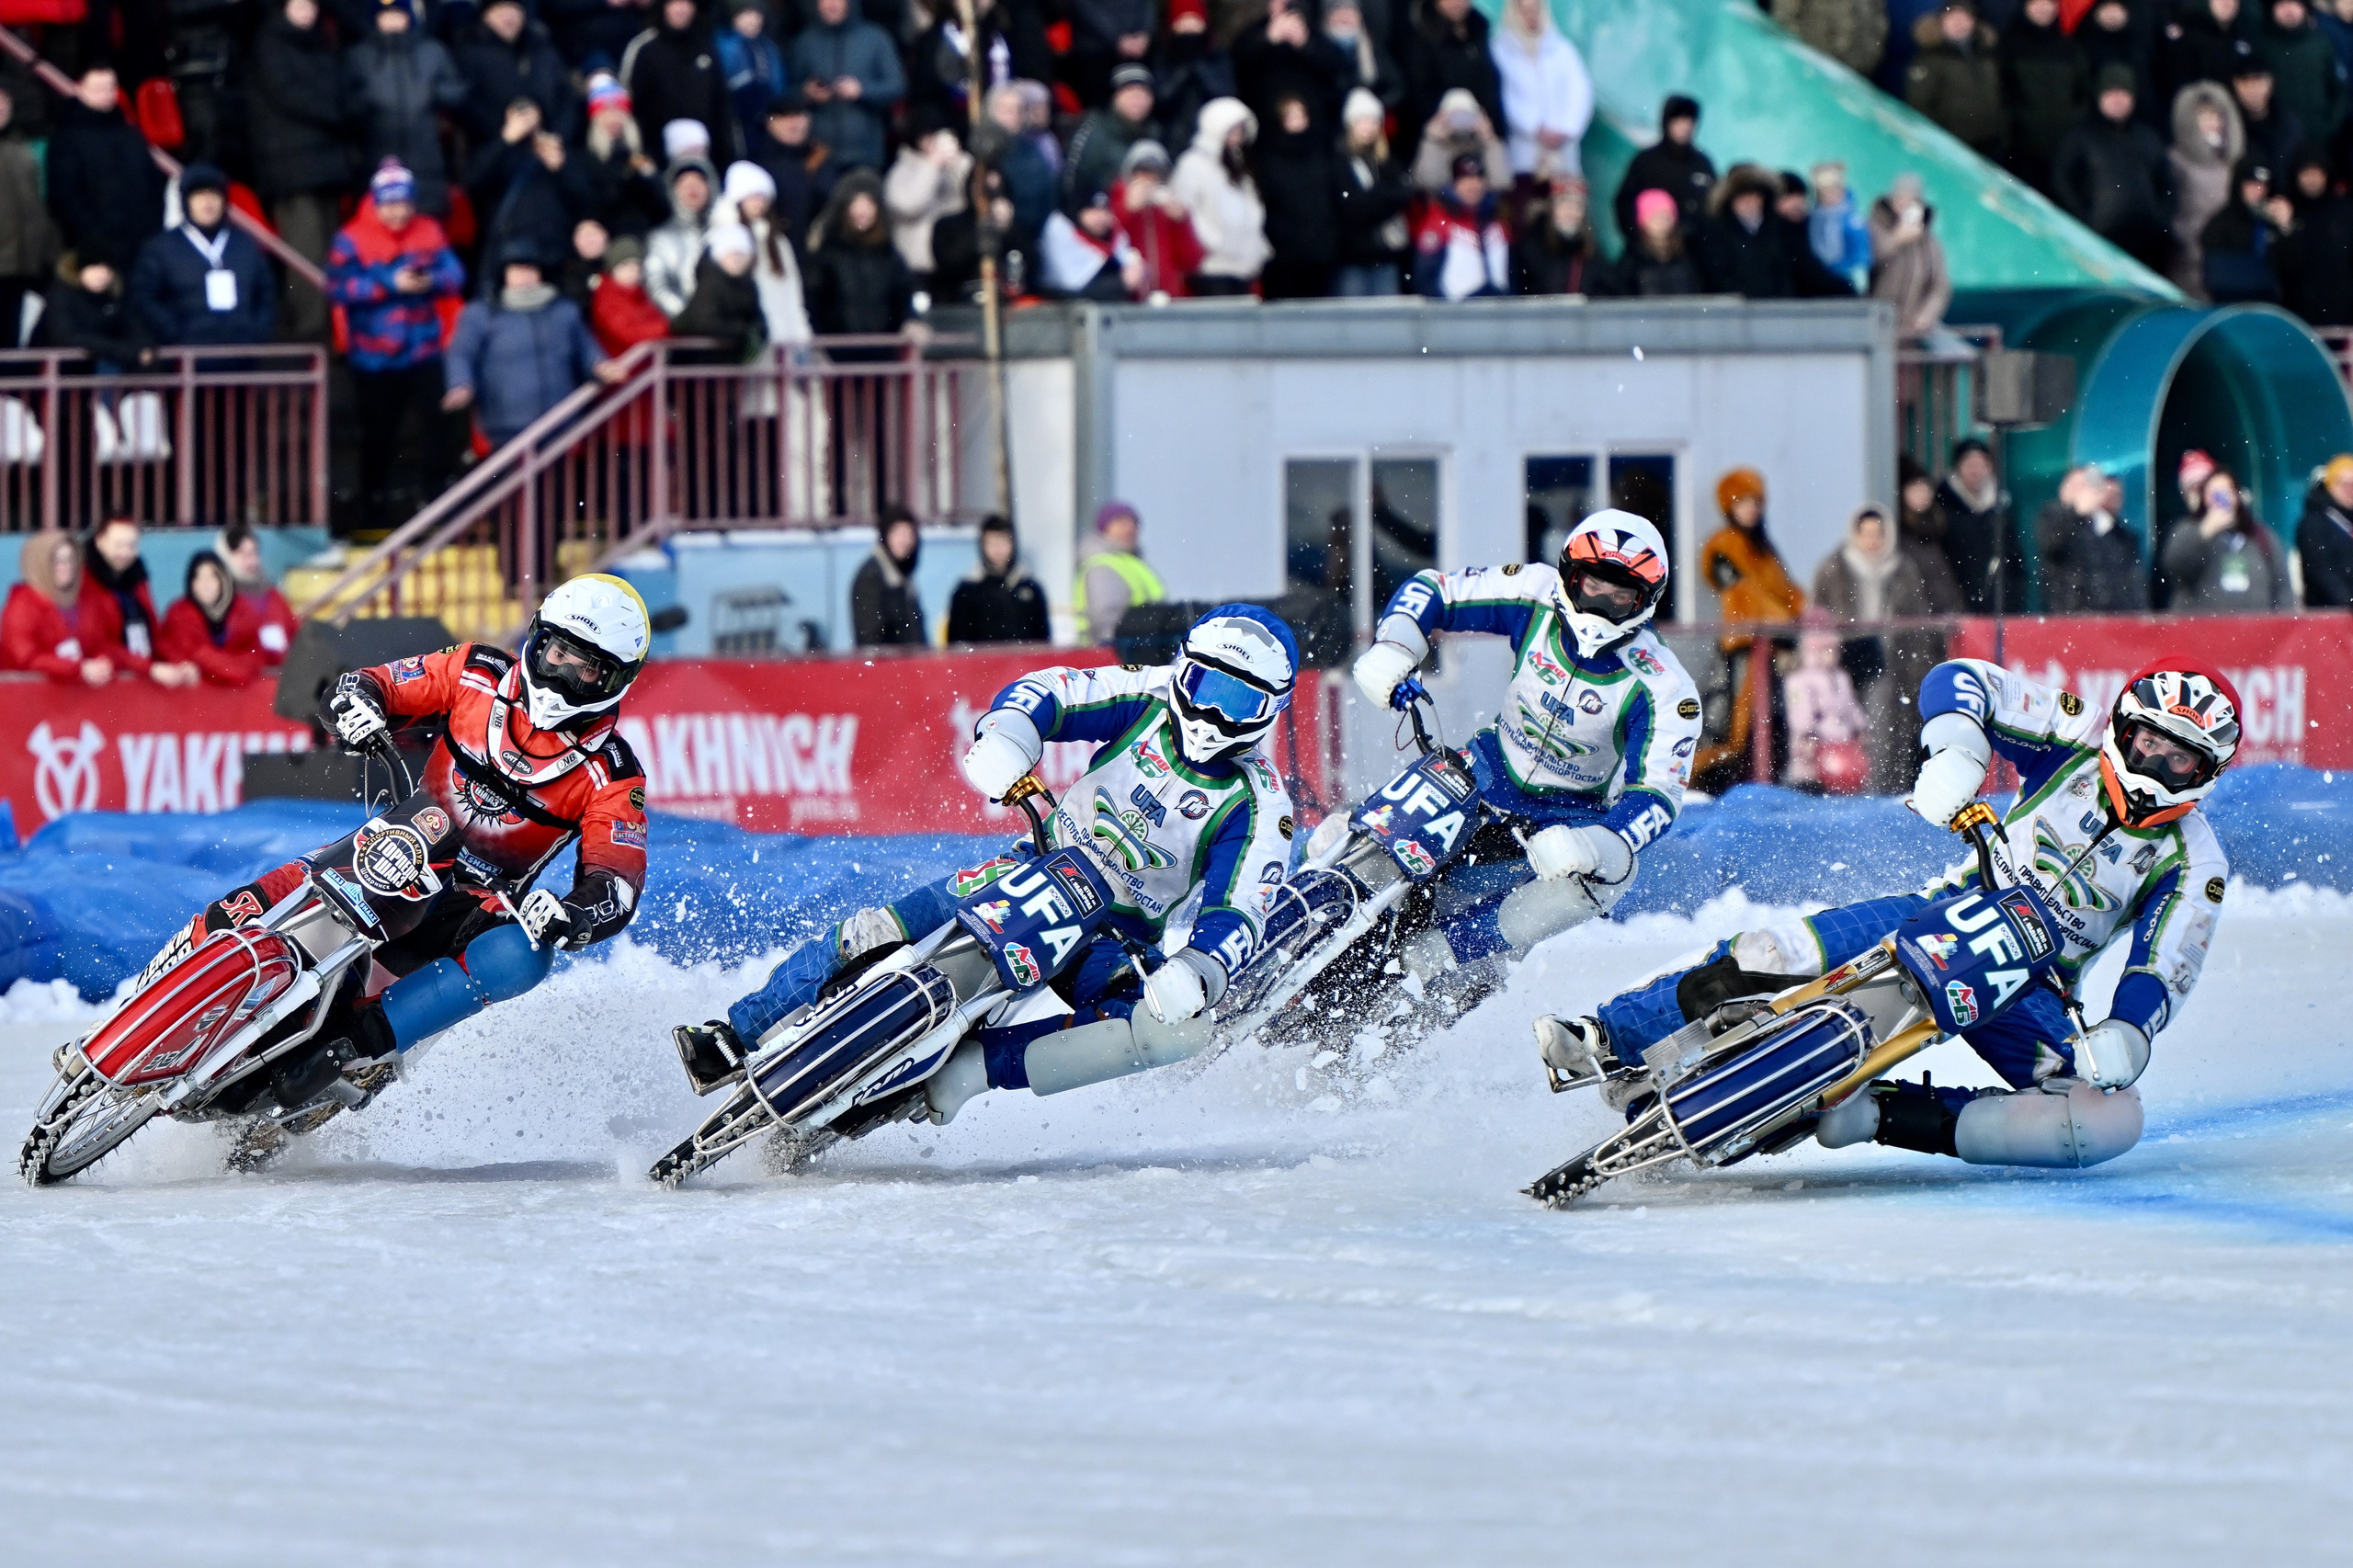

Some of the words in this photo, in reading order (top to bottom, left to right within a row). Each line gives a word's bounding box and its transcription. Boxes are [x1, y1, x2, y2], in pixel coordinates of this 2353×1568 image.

[570, 614, 598, 632] SHOEI
[1222, 643, 1251, 661] SHOEI
[1540, 691, 1575, 726] UFA
[2176, 706, 2203, 725] SHOEI
[502, 751, 532, 774] ORTEMA
[616, 712, 859, 796] AKHNICH
[1131, 783, 1167, 828] UFA
[1381, 768, 1466, 853] UFA
[1058, 808, 1086, 846] РЕСПУБЛ
[1619, 802, 1673, 855] UFA
[367, 829, 417, 846] СПОРТИВНЫЙ
[414, 842, 424, 865] КЛУБ
[376, 836, 419, 882] ТОРПЕДО
[467, 857, 499, 874] SHAAZ
[1080, 826, 1145, 890] ПРАВИТЕЛЬСТВО
[372, 856, 406, 889] ШААЗ
[219, 891, 264, 927] SR
[358, 901, 378, 923] SHAAZ
[997, 862, 1084, 969] UFA
[2018, 864, 2086, 931] ПРАВИТЕЛЬСТВО
[1209, 922, 1256, 972] UFA
[1944, 893, 2030, 1010] UFA
[1859, 957, 1892, 979] SUSPENSION
